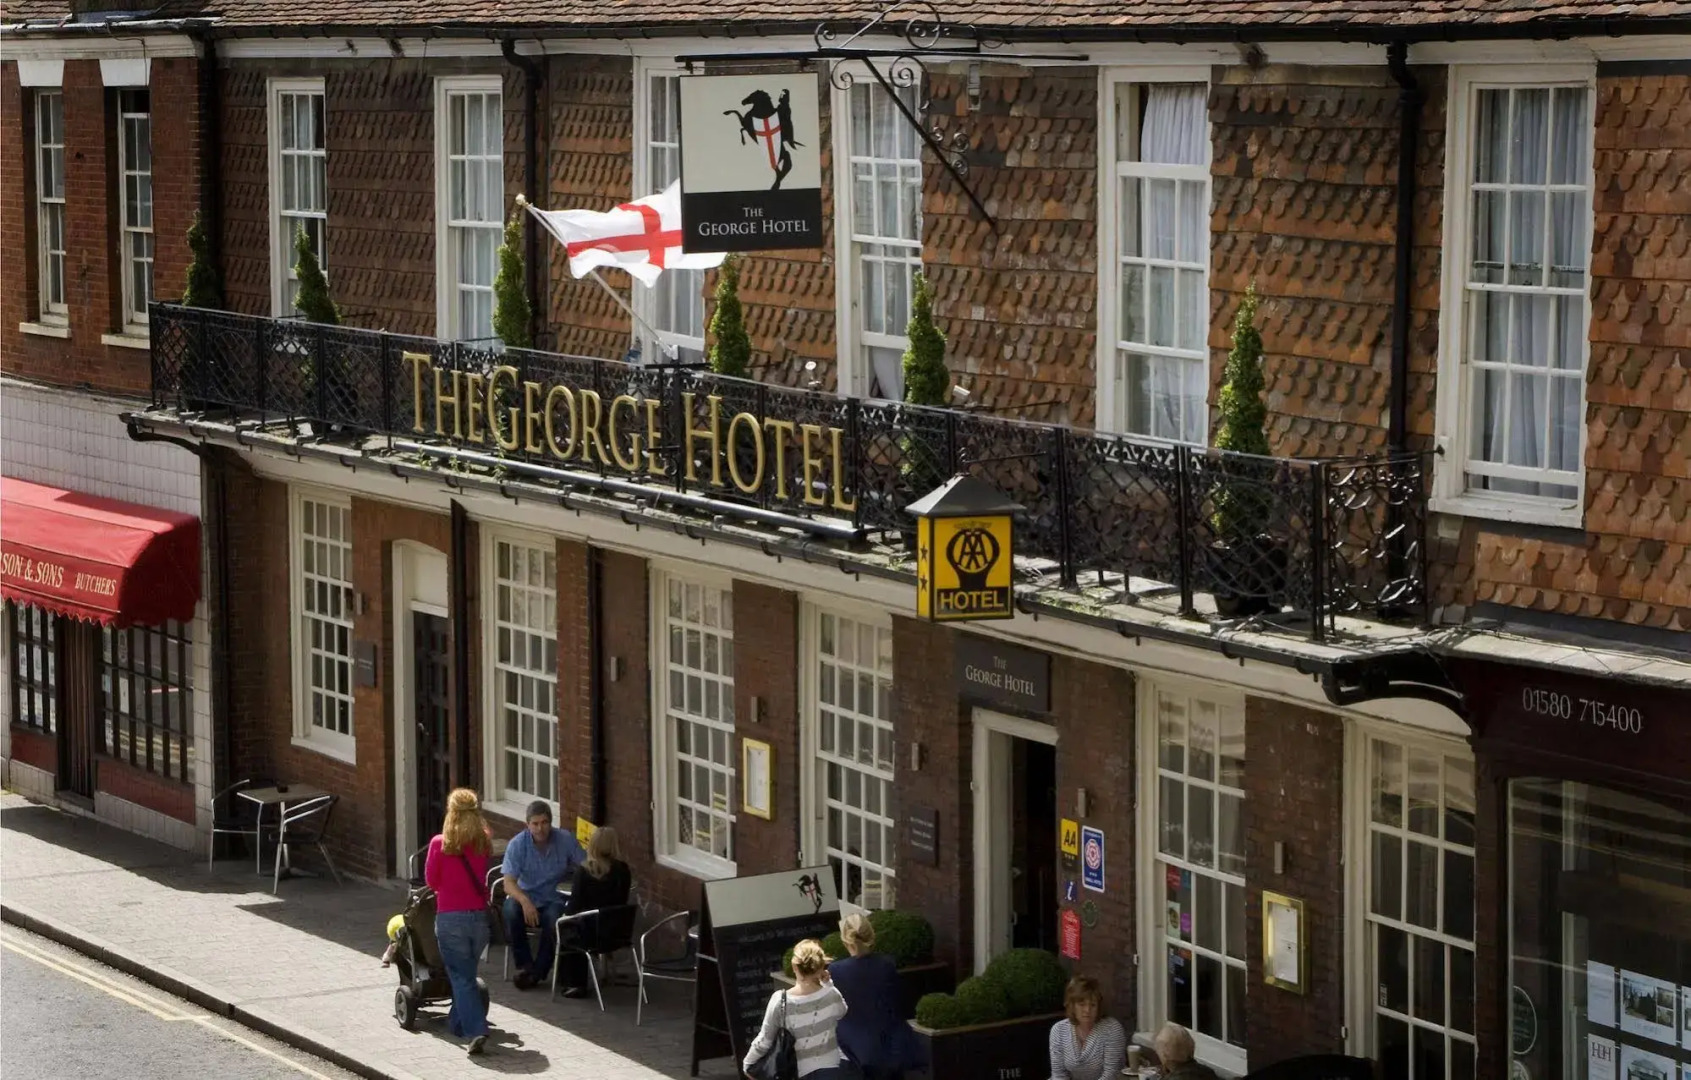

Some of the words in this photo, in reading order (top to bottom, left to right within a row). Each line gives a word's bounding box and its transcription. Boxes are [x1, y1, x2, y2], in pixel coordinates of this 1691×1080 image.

[742, 207, 764, 218] THE
[698, 221, 757, 236] GEORGE
[762, 219, 810, 234] HOTEL
[402, 350, 485, 443] THE
[486, 365, 666, 476] GEORGE
[683, 391, 858, 512] HOTEL
[0, 552, 24, 578] SON
[24, 559, 34, 581] &
[35, 561, 64, 588] SONS
[75, 572, 117, 597] BUTCHERS
[940, 590, 1004, 610] HOTEL
[993, 656, 1007, 670] THE
[965, 664, 1002, 688] GEORGE
[1004, 674, 1036, 697] HOTEL
[1522, 687, 1571, 719] 01580
[1578, 698, 1642, 734] 715400
[1064, 829, 1076, 847] AA
[999, 1067, 1021, 1080] THE
